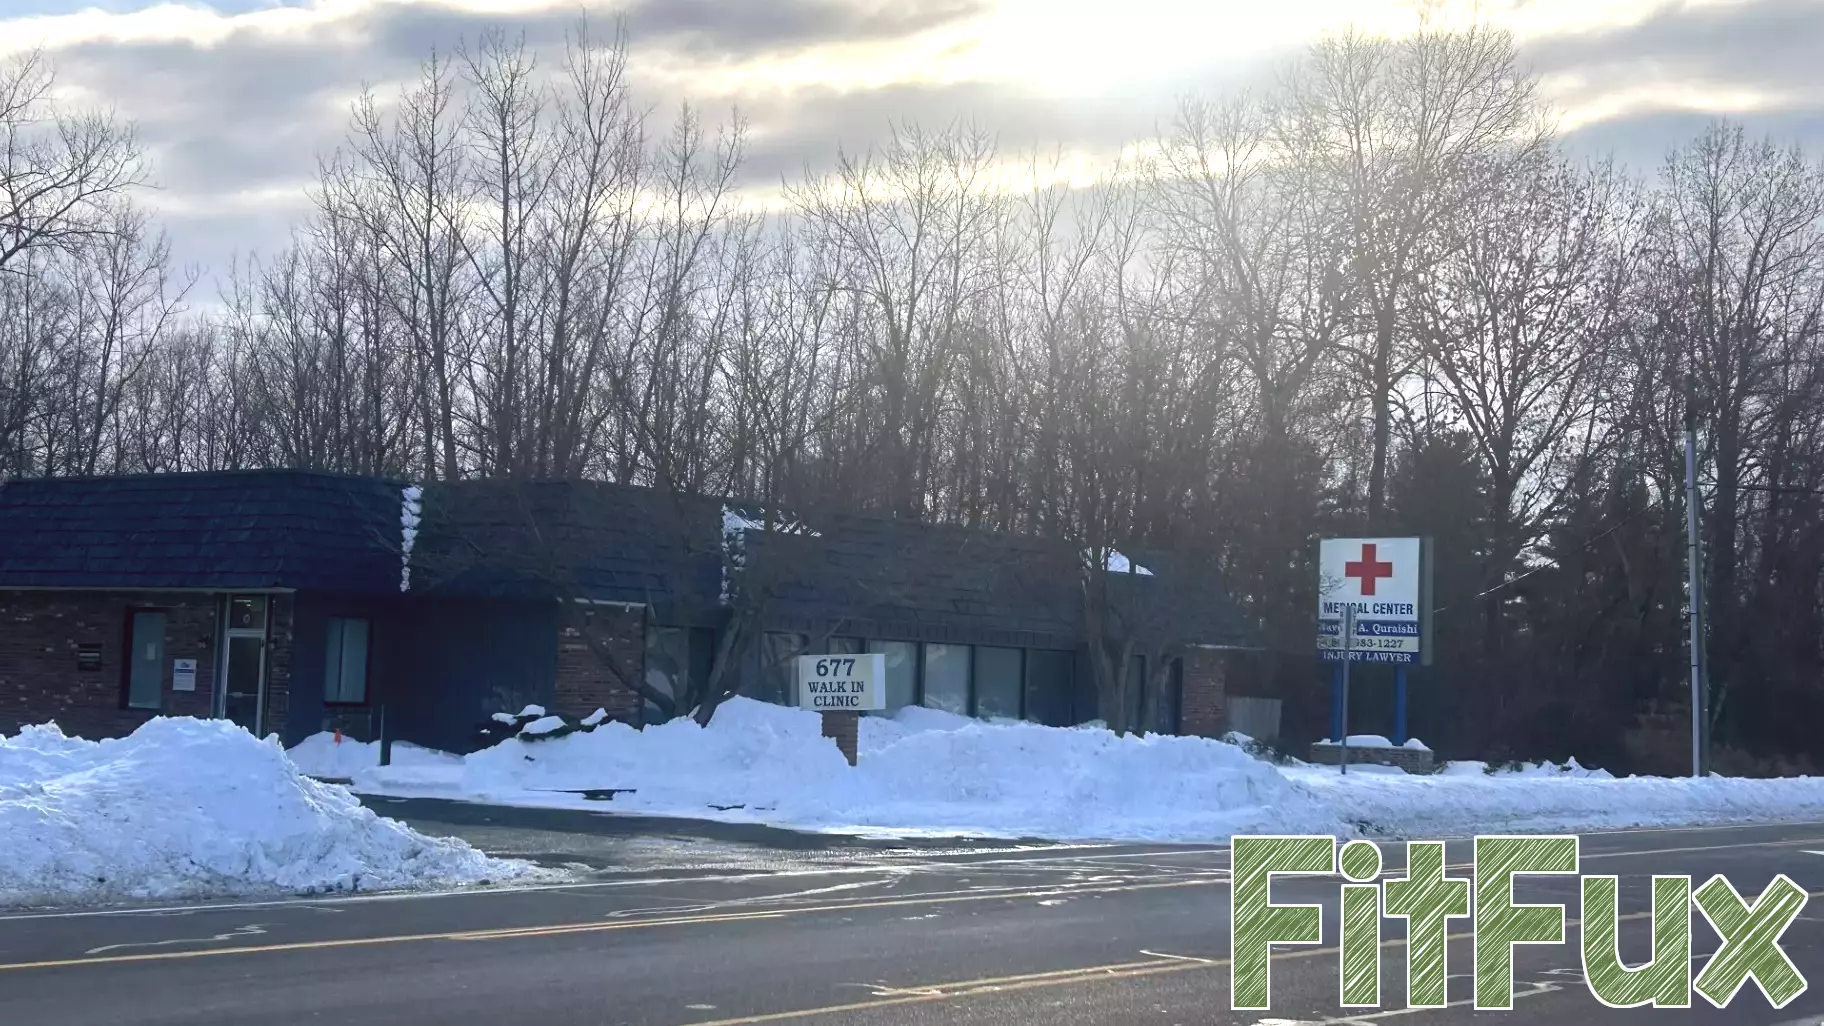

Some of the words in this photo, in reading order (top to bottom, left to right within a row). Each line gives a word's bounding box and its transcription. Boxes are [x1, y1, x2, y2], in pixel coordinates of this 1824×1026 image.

[1373, 603, 1413, 615] CENTER
[1358, 623, 1369, 633] A.
[1372, 623, 1418, 634] Quraishi
[1366, 652, 1412, 662] LAWYER
[816, 658, 856, 677] 677
[808, 681, 846, 693] WALK
[851, 681, 864, 693] IN
[813, 695, 860, 707] CLINIC
